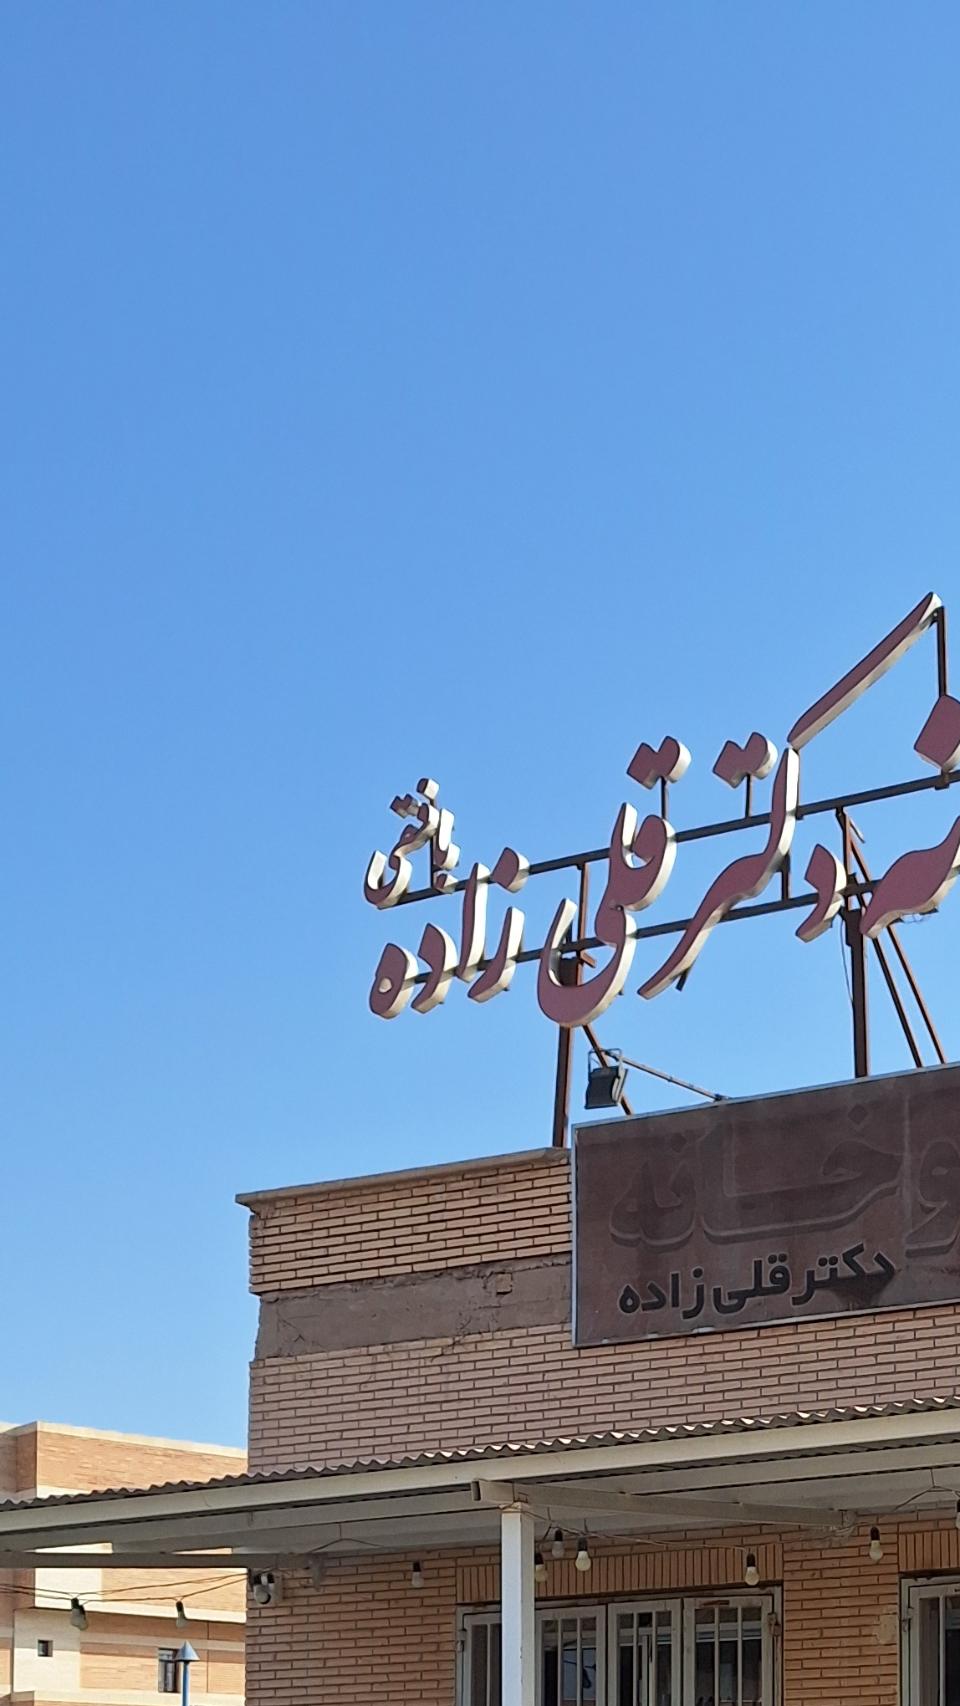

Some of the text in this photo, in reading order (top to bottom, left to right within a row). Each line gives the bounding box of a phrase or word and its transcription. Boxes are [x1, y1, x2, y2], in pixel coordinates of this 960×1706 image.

[537, 736, 692, 1028] قلی
[638, 591, 942, 998] دکتر
[618, 1242, 895, 1320] دکتر قلی زاده
